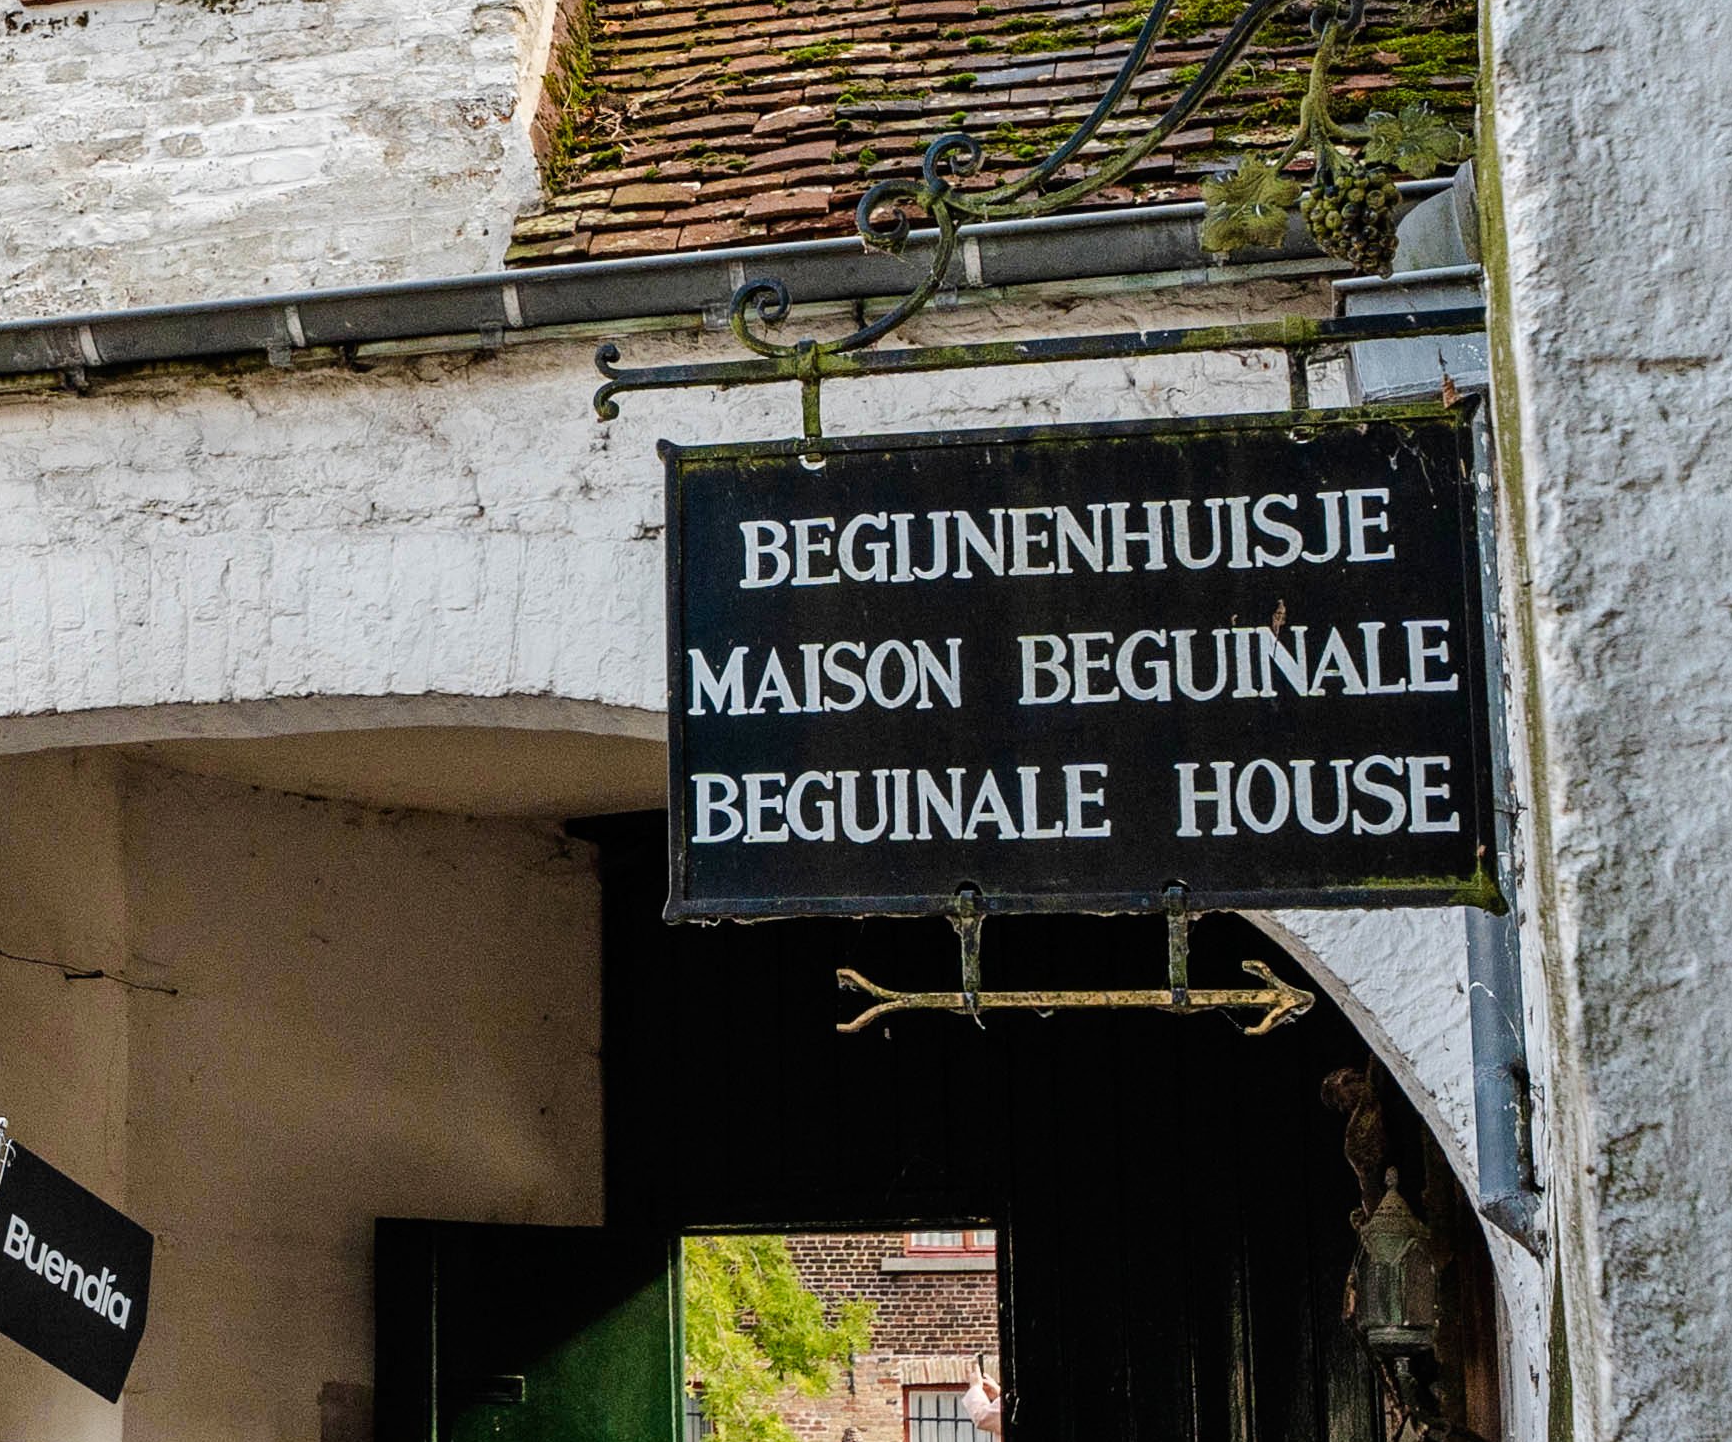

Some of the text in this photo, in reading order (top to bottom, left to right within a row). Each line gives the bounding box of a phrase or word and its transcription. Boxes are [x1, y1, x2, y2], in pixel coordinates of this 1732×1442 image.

[739, 487, 1396, 590] BEGIJNENHUISJE
[687, 619, 1460, 716] MAISON BEGUINALE
[692, 755, 1461, 846] BEGUINALE HOUSE
[3, 1213, 132, 1330] Buendía
